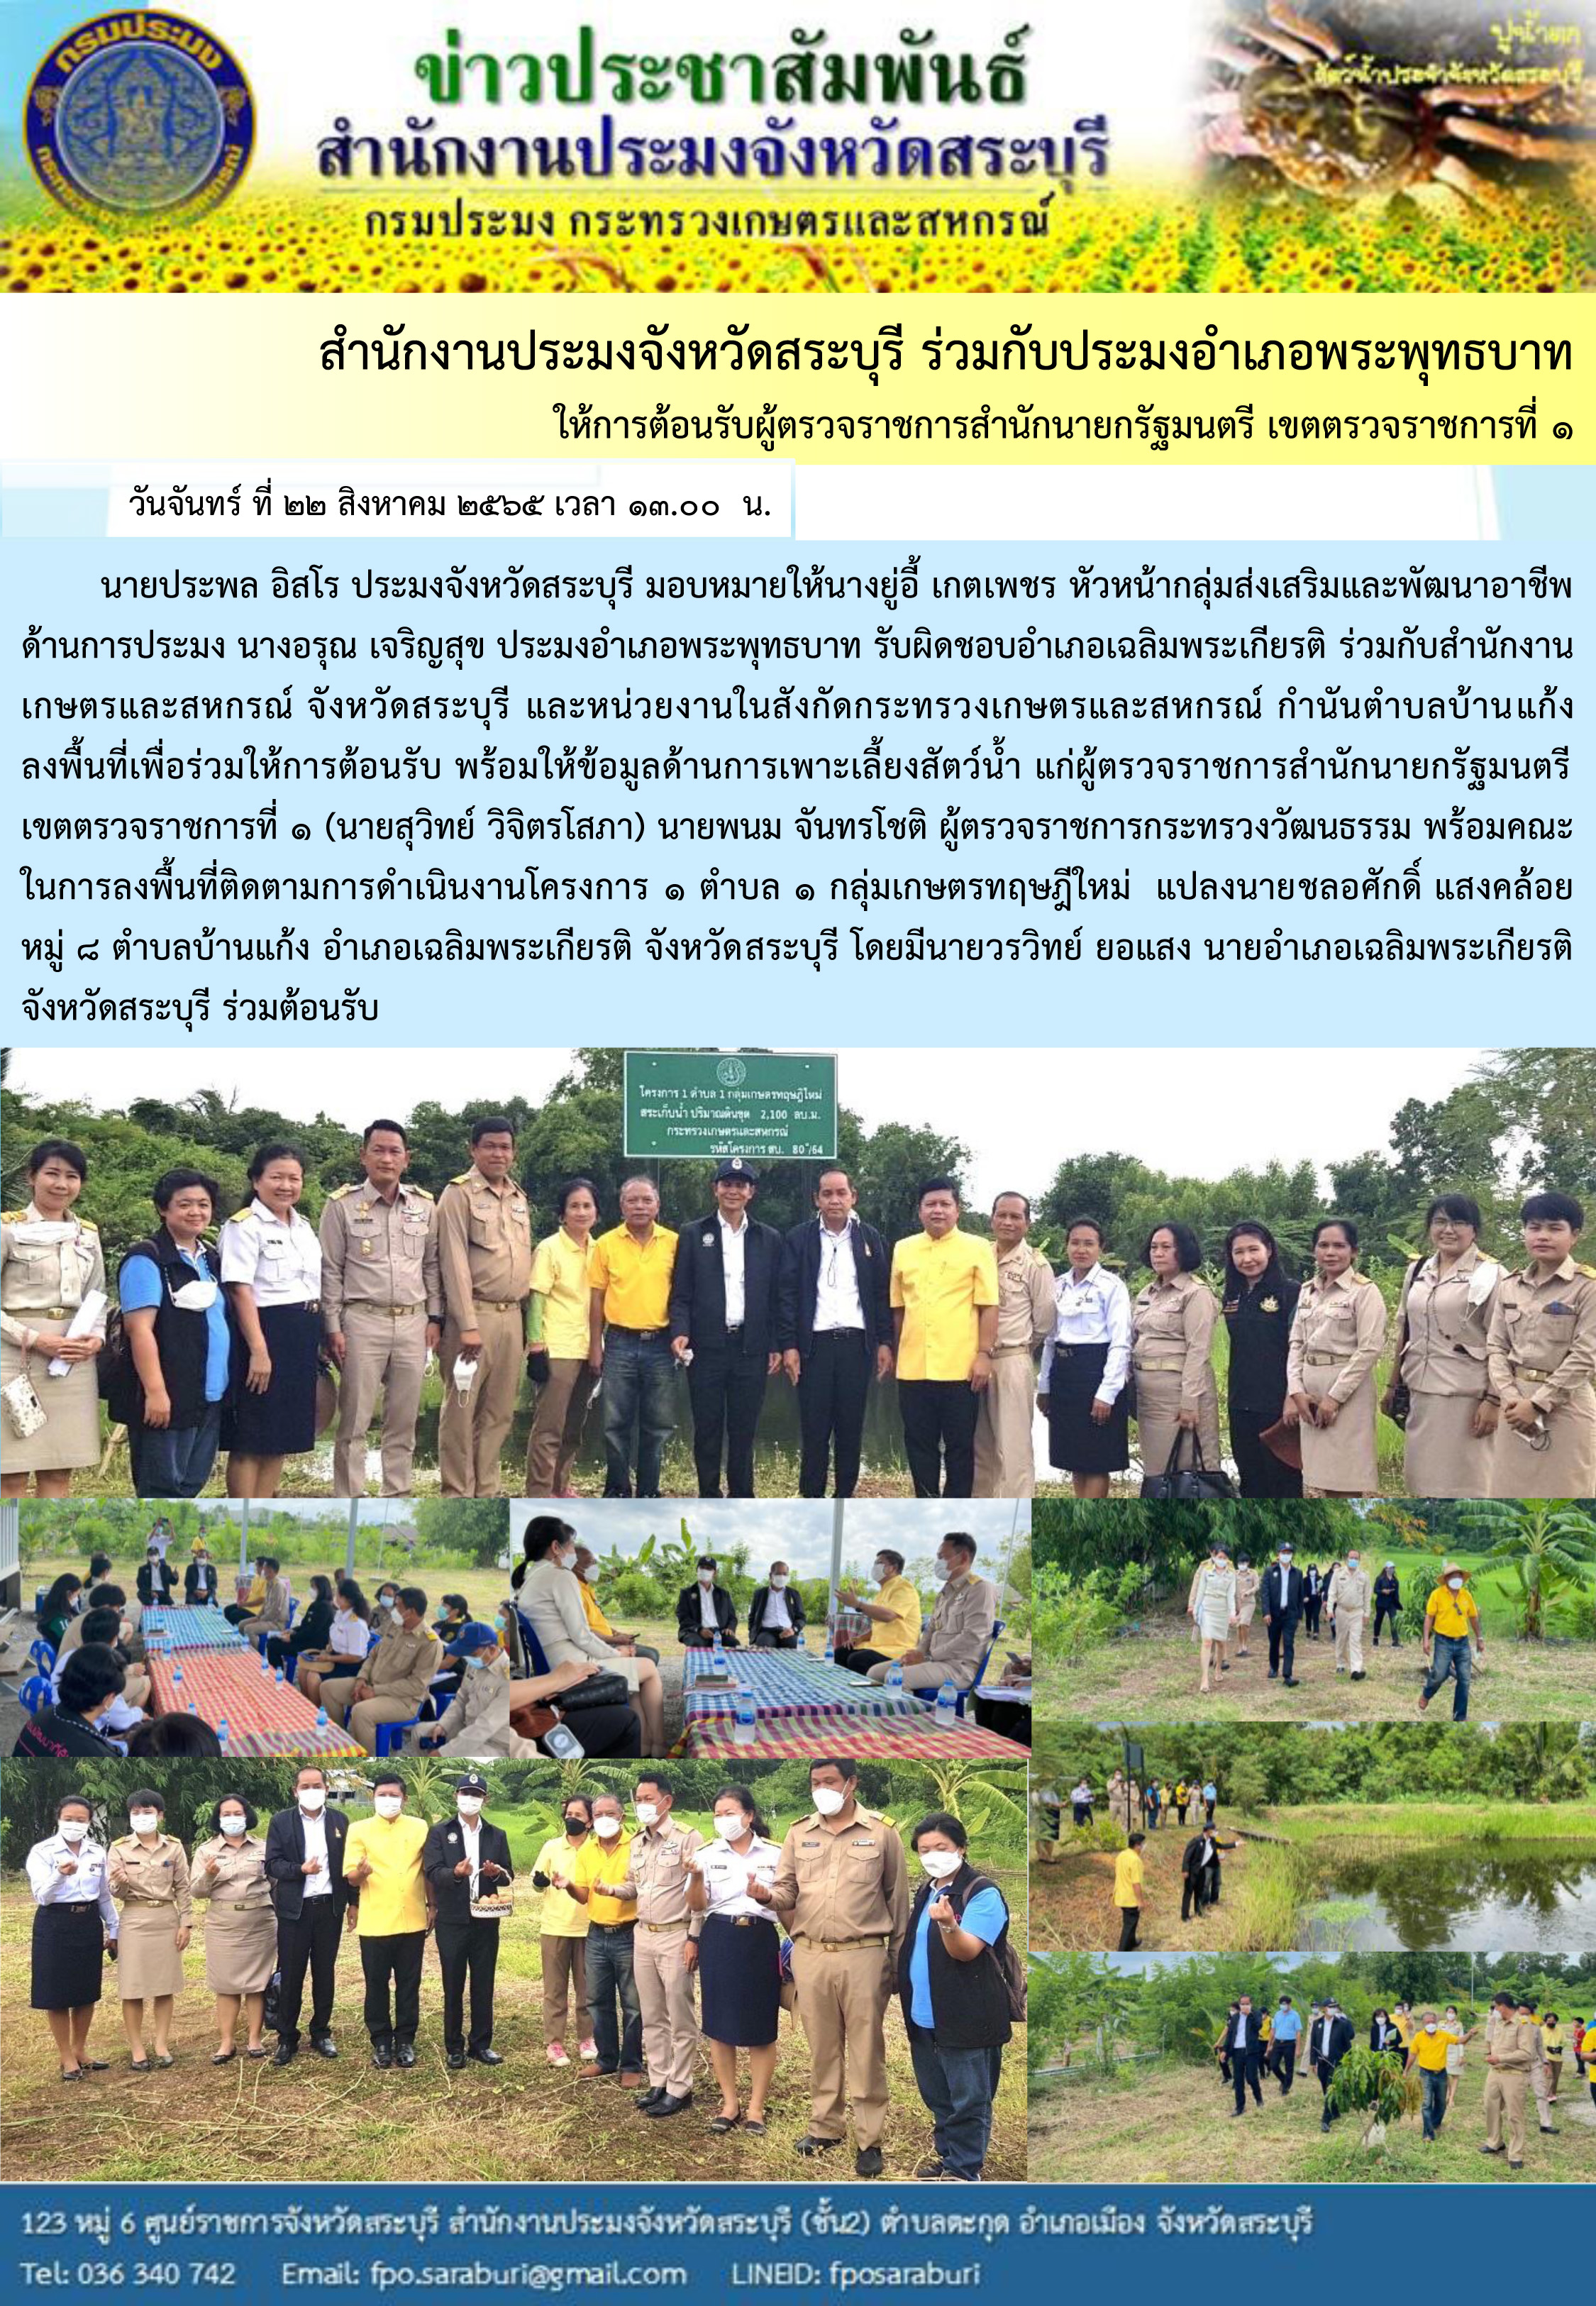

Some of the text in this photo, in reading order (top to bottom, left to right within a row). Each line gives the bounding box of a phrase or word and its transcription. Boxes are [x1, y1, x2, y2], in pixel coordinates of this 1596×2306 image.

[639, 1085, 679, 1098] โครงการ
[682, 1090, 688, 1098] 1
[691, 1086, 716, 1098] ตำบล
[719, 1090, 725, 1099] 1
[760, 1110, 787, 1120] 2,100
[667, 1125, 789, 1137] กระทรวงเกษตรและสหกรณ์
[710, 1141, 766, 1154] รหัสโครงการ
